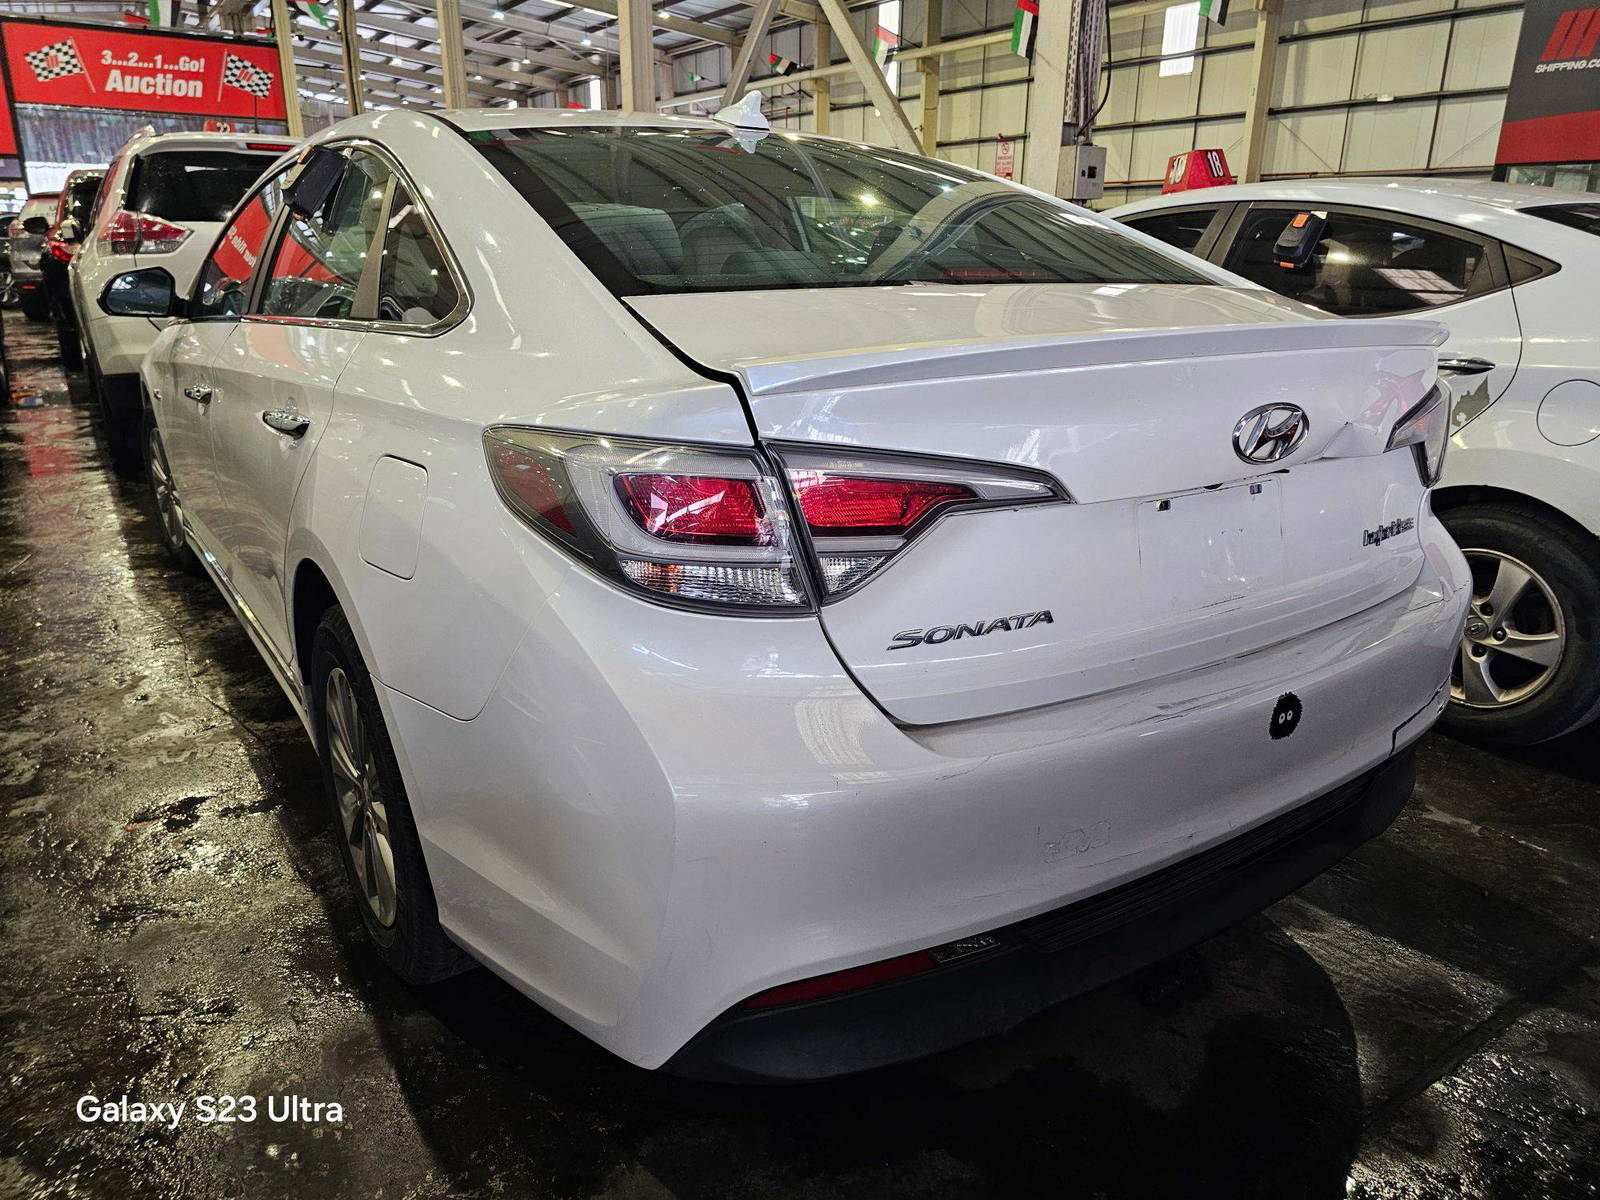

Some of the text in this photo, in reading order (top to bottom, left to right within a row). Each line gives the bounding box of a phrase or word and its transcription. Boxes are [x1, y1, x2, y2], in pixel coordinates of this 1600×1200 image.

[105, 69, 203, 98] Auction
[1207, 151, 1224, 177] 18
[886, 609, 1054, 651] SONATA
